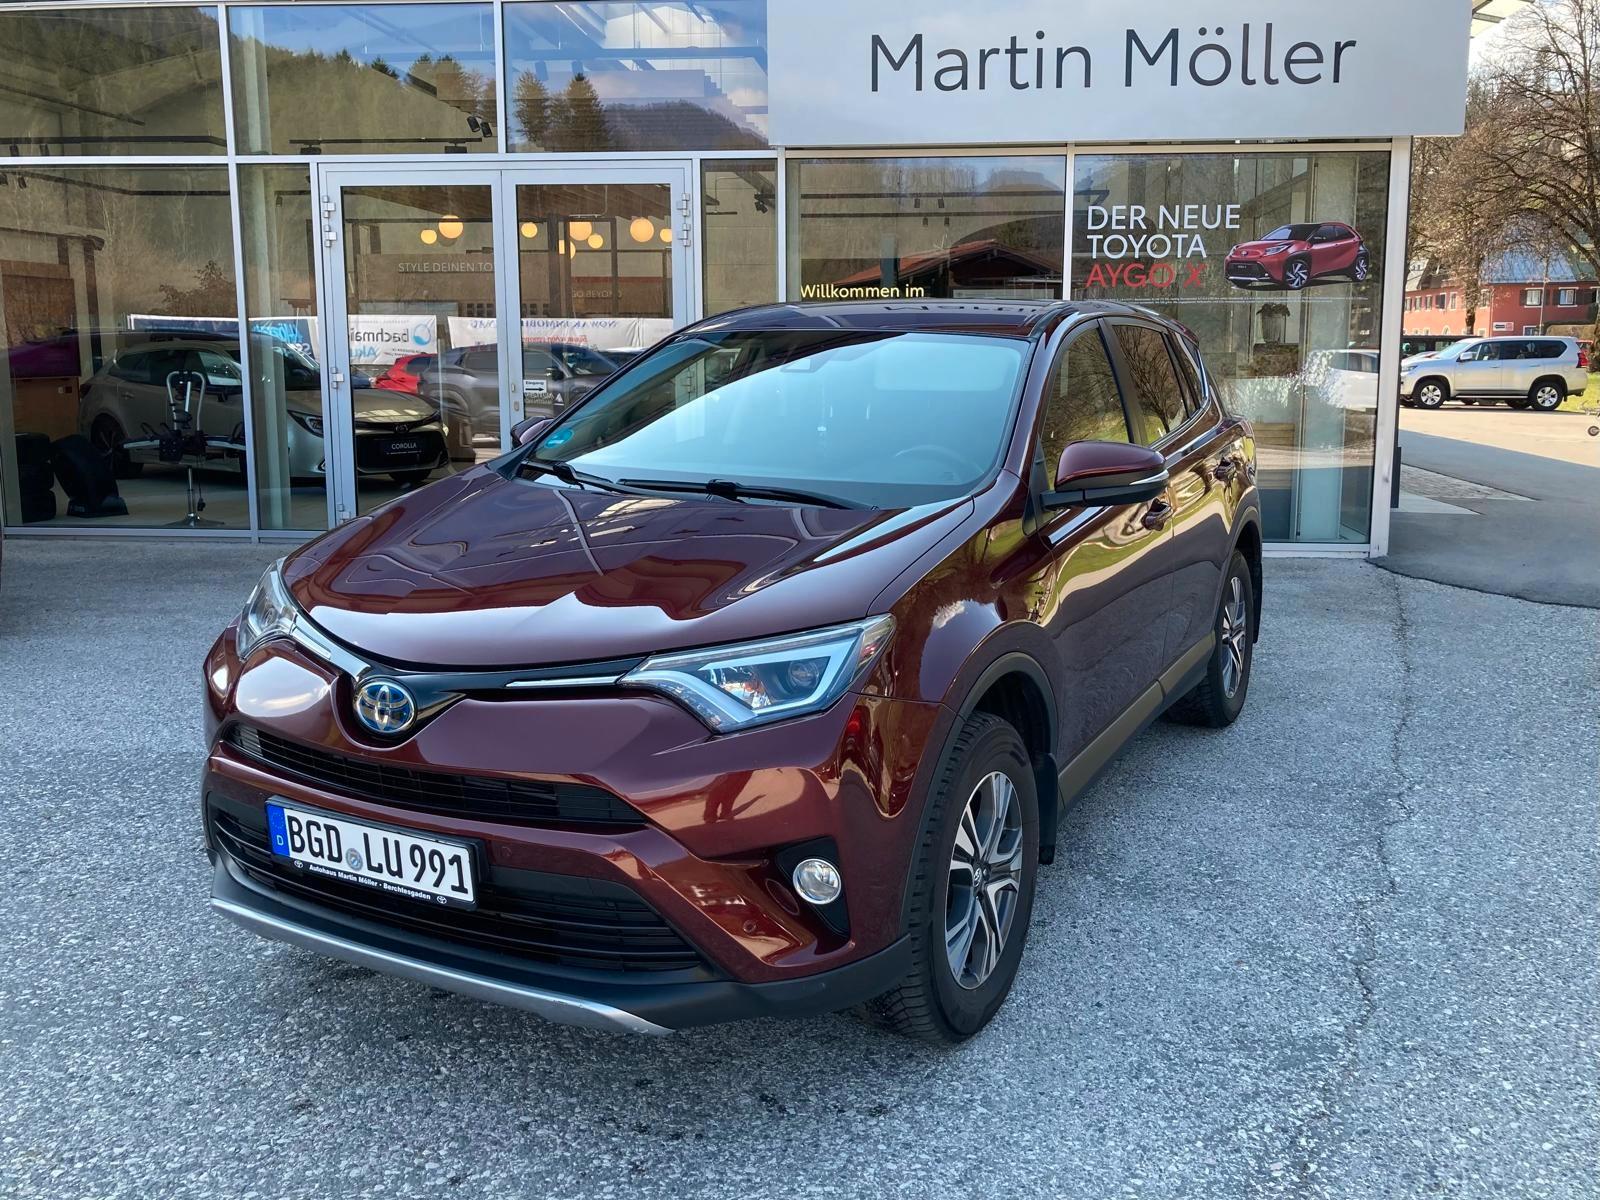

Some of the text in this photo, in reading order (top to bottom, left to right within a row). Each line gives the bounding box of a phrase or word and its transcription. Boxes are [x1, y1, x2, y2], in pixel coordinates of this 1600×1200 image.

[870, 22, 1358, 92] Martin Möller
[1087, 204, 1241, 230] DER NEUE
[1087, 234, 1208, 260] TOYOTA
[398, 262, 430, 272] STYLE
[432, 262, 475, 272] DEINEN
[1085, 262, 1208, 288] AYGO X
[800, 283, 925, 298] Willkommen im
[276, 834, 284, 846] D
[287, 815, 469, 894] BGD LU 991
[309, 863, 431, 900] Autohaus Martin Möller Berchtesgaden
